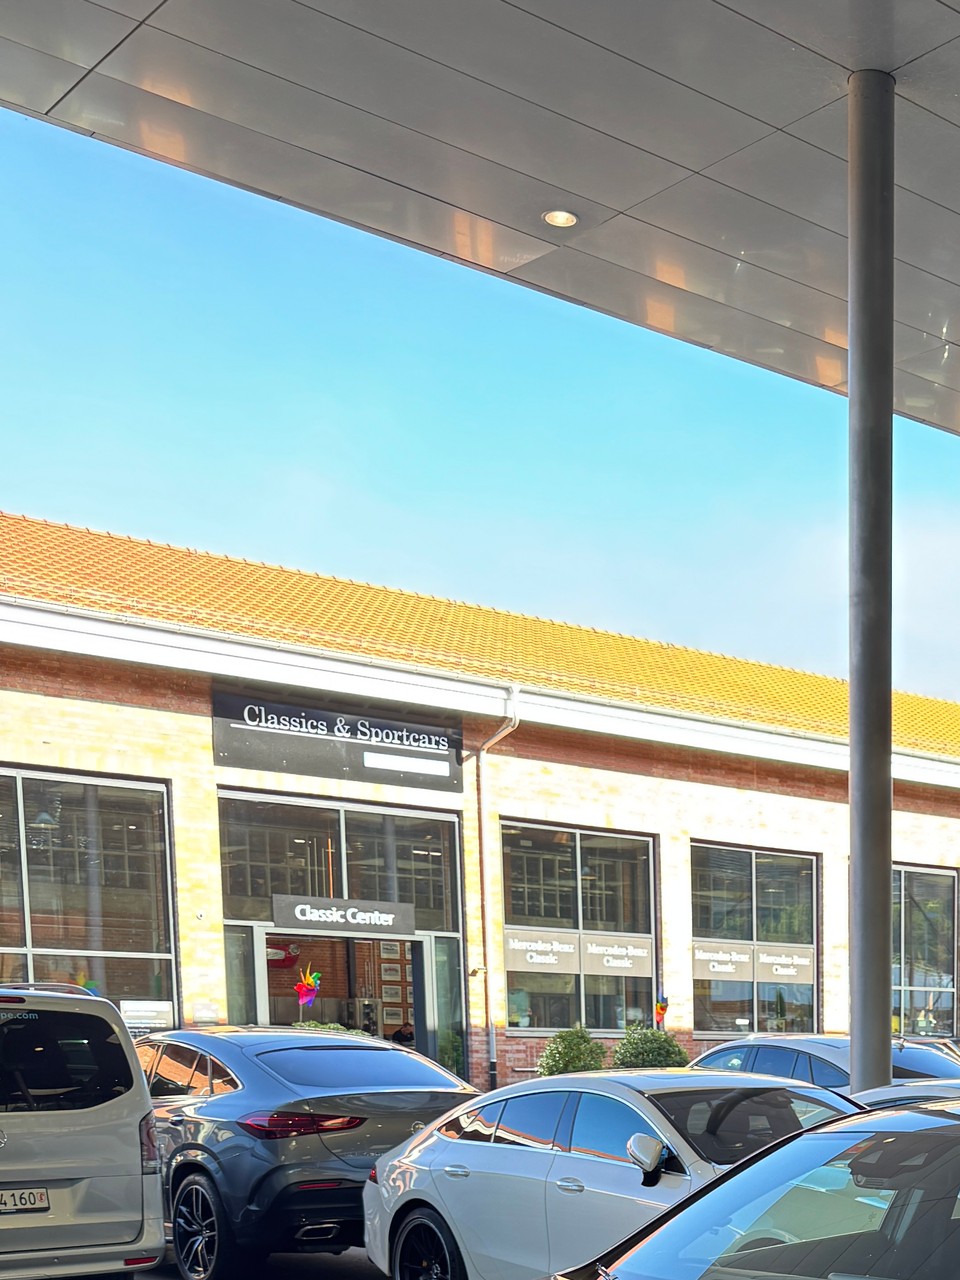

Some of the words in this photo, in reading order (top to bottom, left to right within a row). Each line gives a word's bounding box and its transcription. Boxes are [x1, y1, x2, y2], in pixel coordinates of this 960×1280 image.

[243, 704, 328, 735] Classics
[334, 717, 351, 738] &
[356, 719, 449, 751] Sportcars
[294, 904, 346, 923] Classic
[346, 907, 395, 926] Center
[508, 938, 575, 953] Mercedes-Benz
[587, 943, 648, 957] Mercedes-Benz
[526, 952, 558, 964] Classic
[603, 956, 633, 968] Classic
